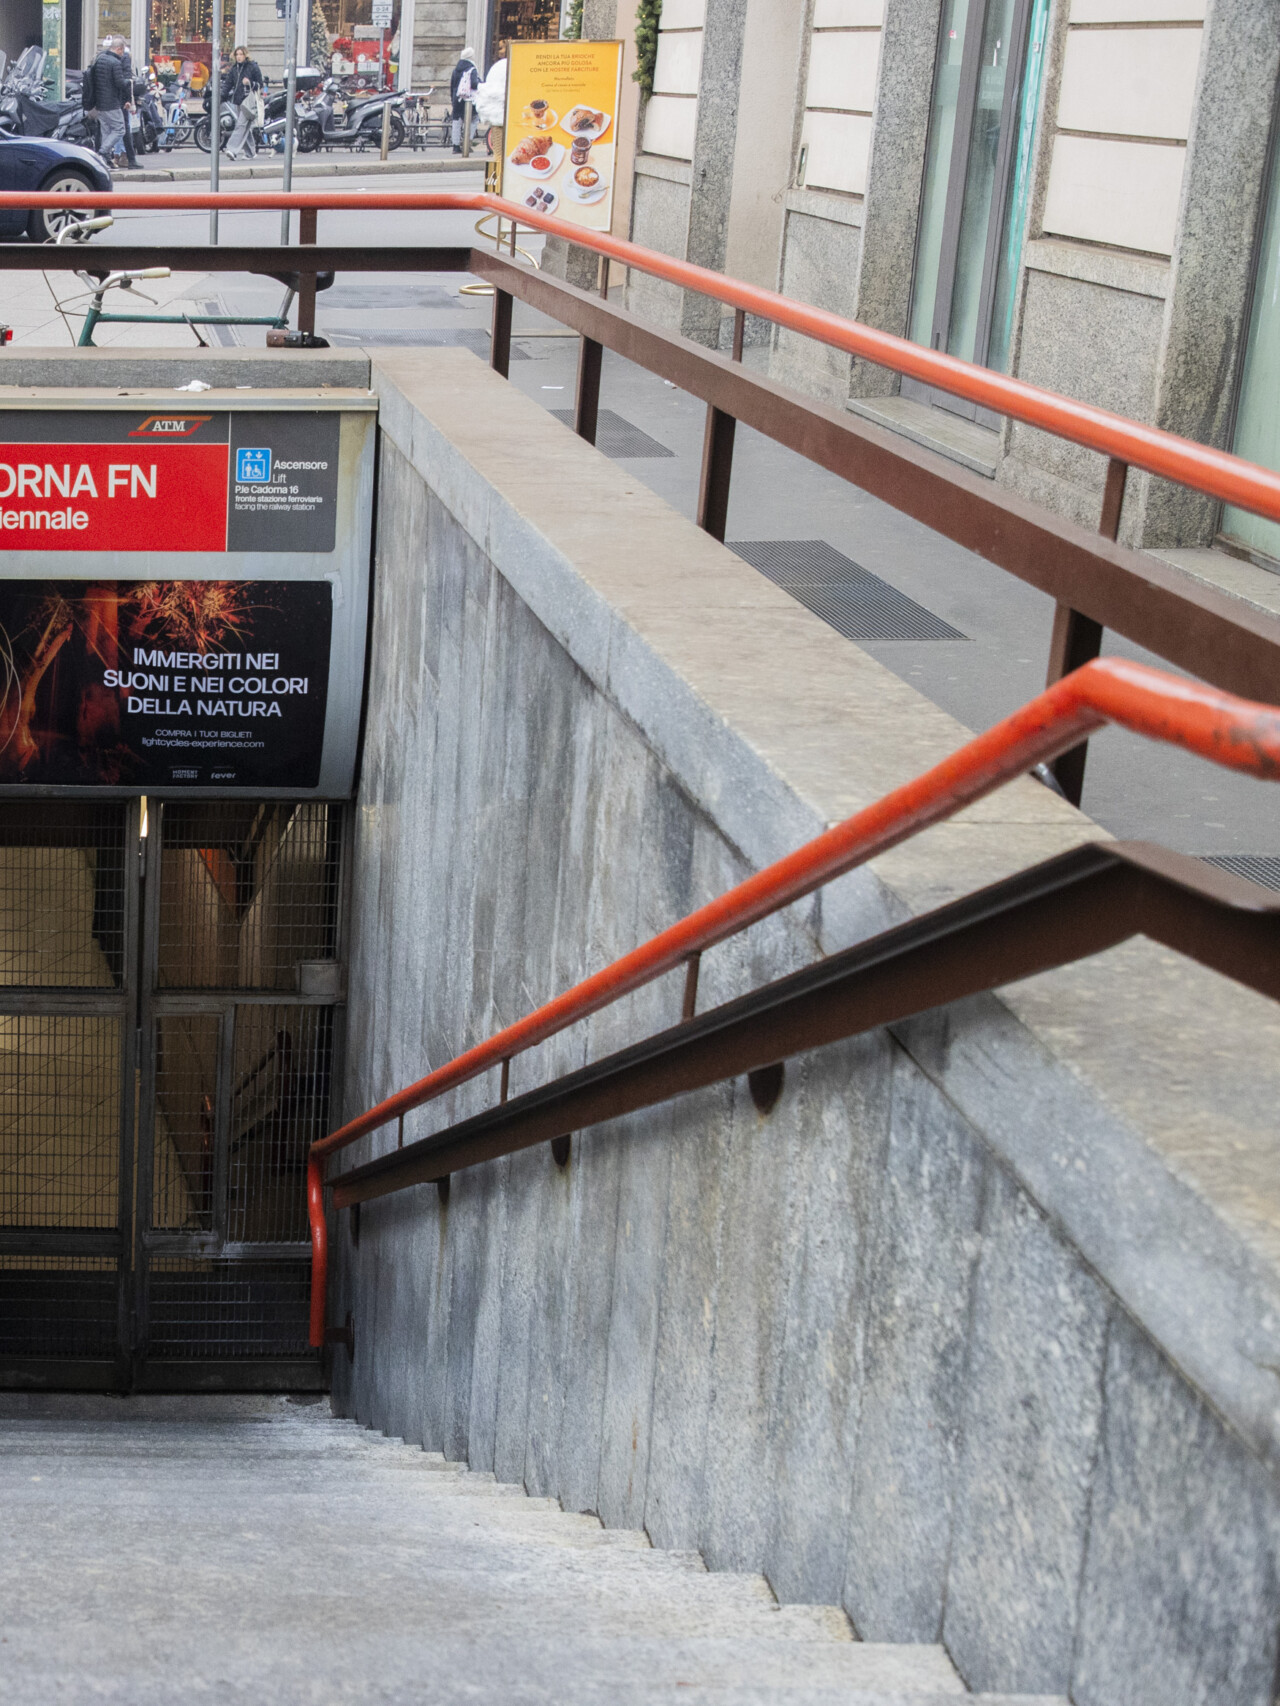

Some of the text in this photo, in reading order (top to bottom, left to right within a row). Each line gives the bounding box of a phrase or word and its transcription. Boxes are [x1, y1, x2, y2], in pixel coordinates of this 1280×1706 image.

[152, 421, 186, 432] ATM
[273, 460, 328, 470] Ascensore
[108, 464, 157, 498] FN
[273, 474, 287, 483] Lift
[250, 486, 288, 494] Cadorna
[289, 486, 299, 494] 16
[257, 495, 287, 503] stazione
[235, 503, 255, 511] facing
[133, 647, 279, 670] IMMERGITI NEI
[103, 669, 308, 694] SUONI E NEI COLORI
[127, 696, 282, 717] DELLA NATURA
[155, 729, 192, 737] COMPRA
[200, 730, 218, 738] TUOI
[142, 737, 264, 748] lightcycles-experience.com
